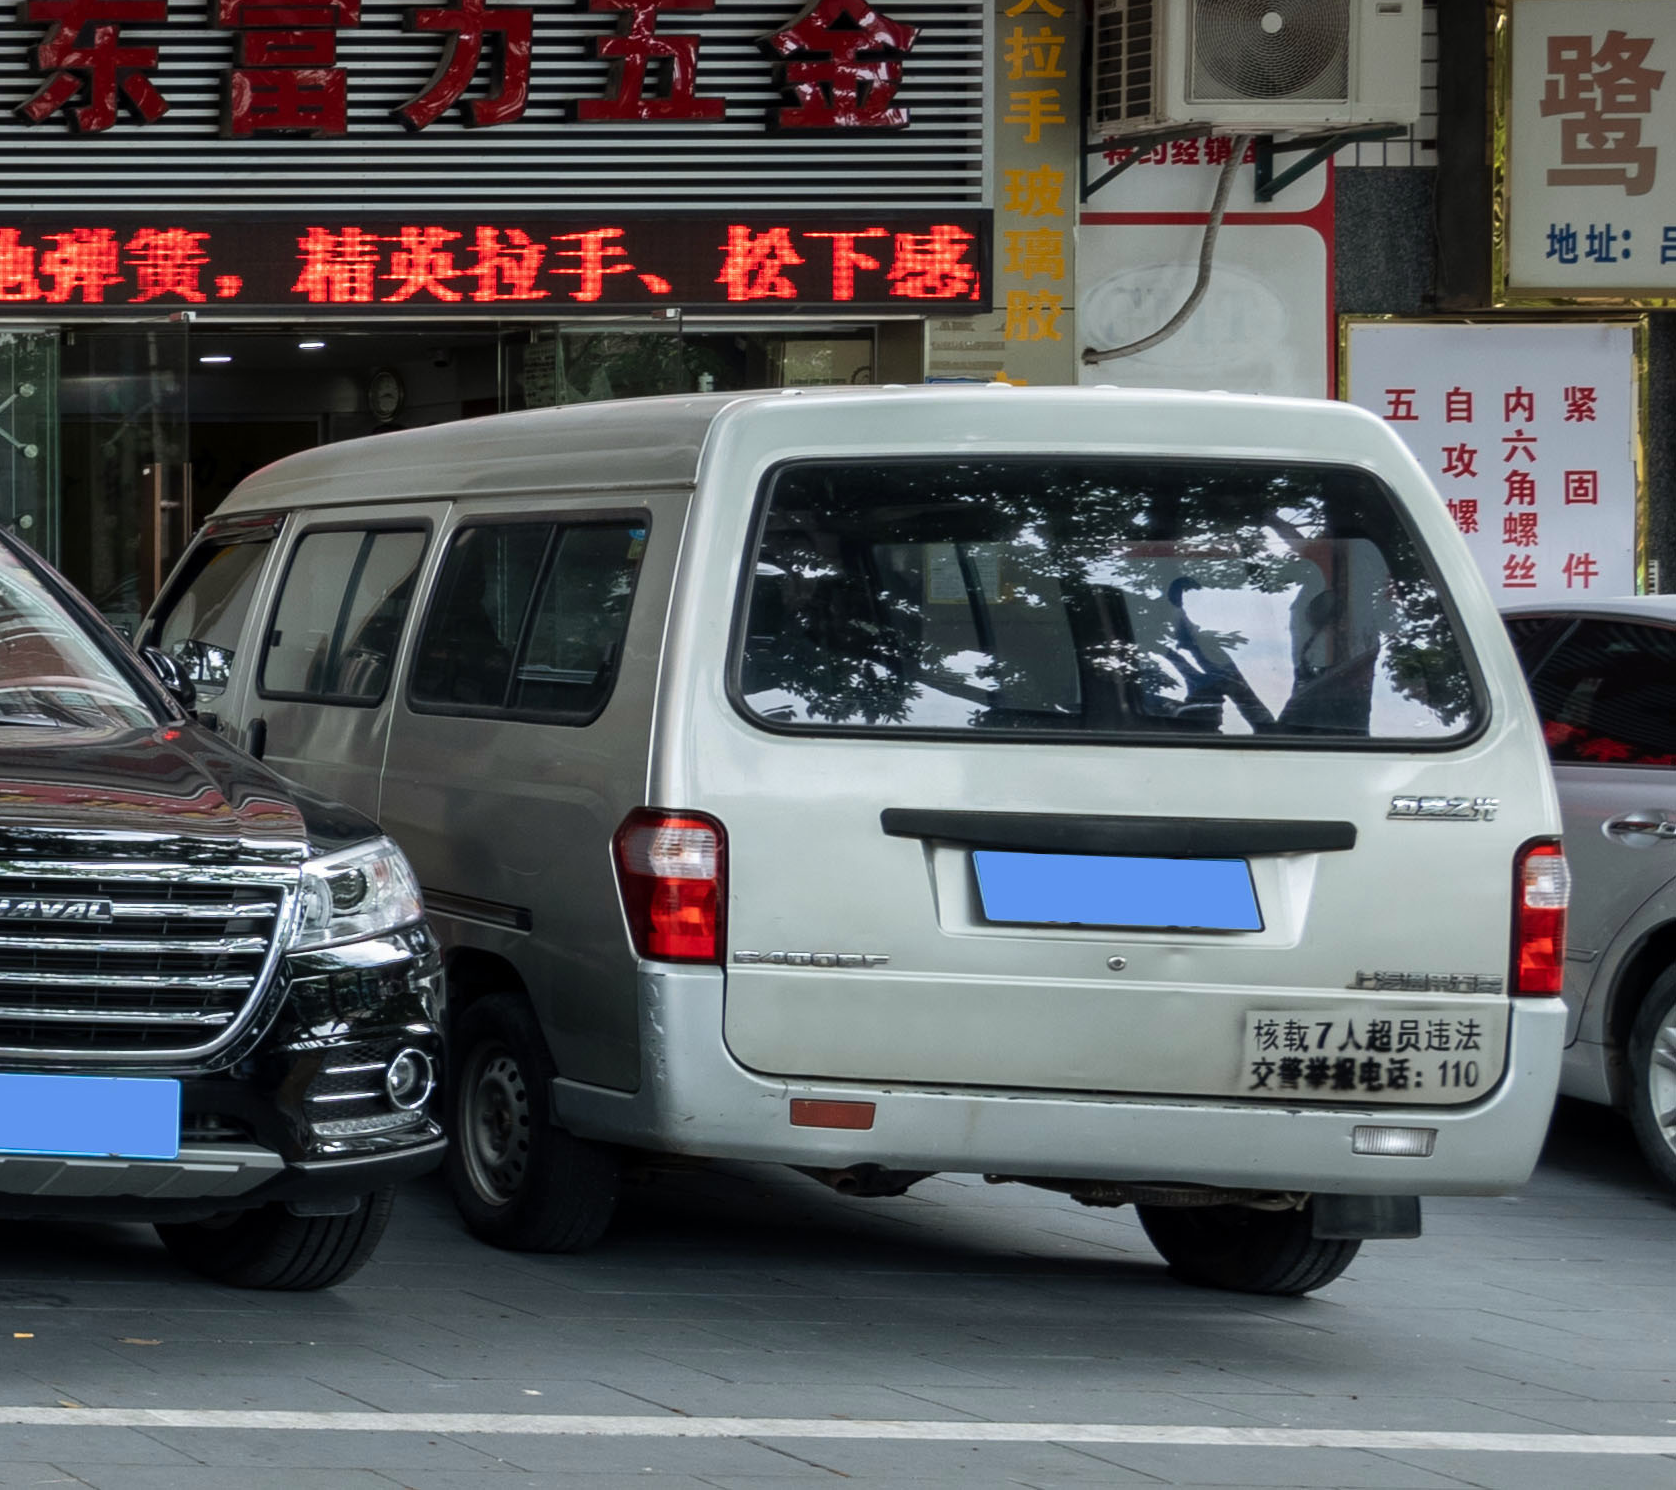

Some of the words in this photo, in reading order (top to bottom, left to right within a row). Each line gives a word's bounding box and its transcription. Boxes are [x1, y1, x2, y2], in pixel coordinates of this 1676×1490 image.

[1539, 29, 1667, 197] 鹭
[1004, 167, 1066, 343] 玻璃胶
[1501, 386, 1538, 588] 内六角螺丝
[1562, 386, 1599, 589] 紧固件
[1253, 1019, 1483, 1053] 核载7人超员违法
